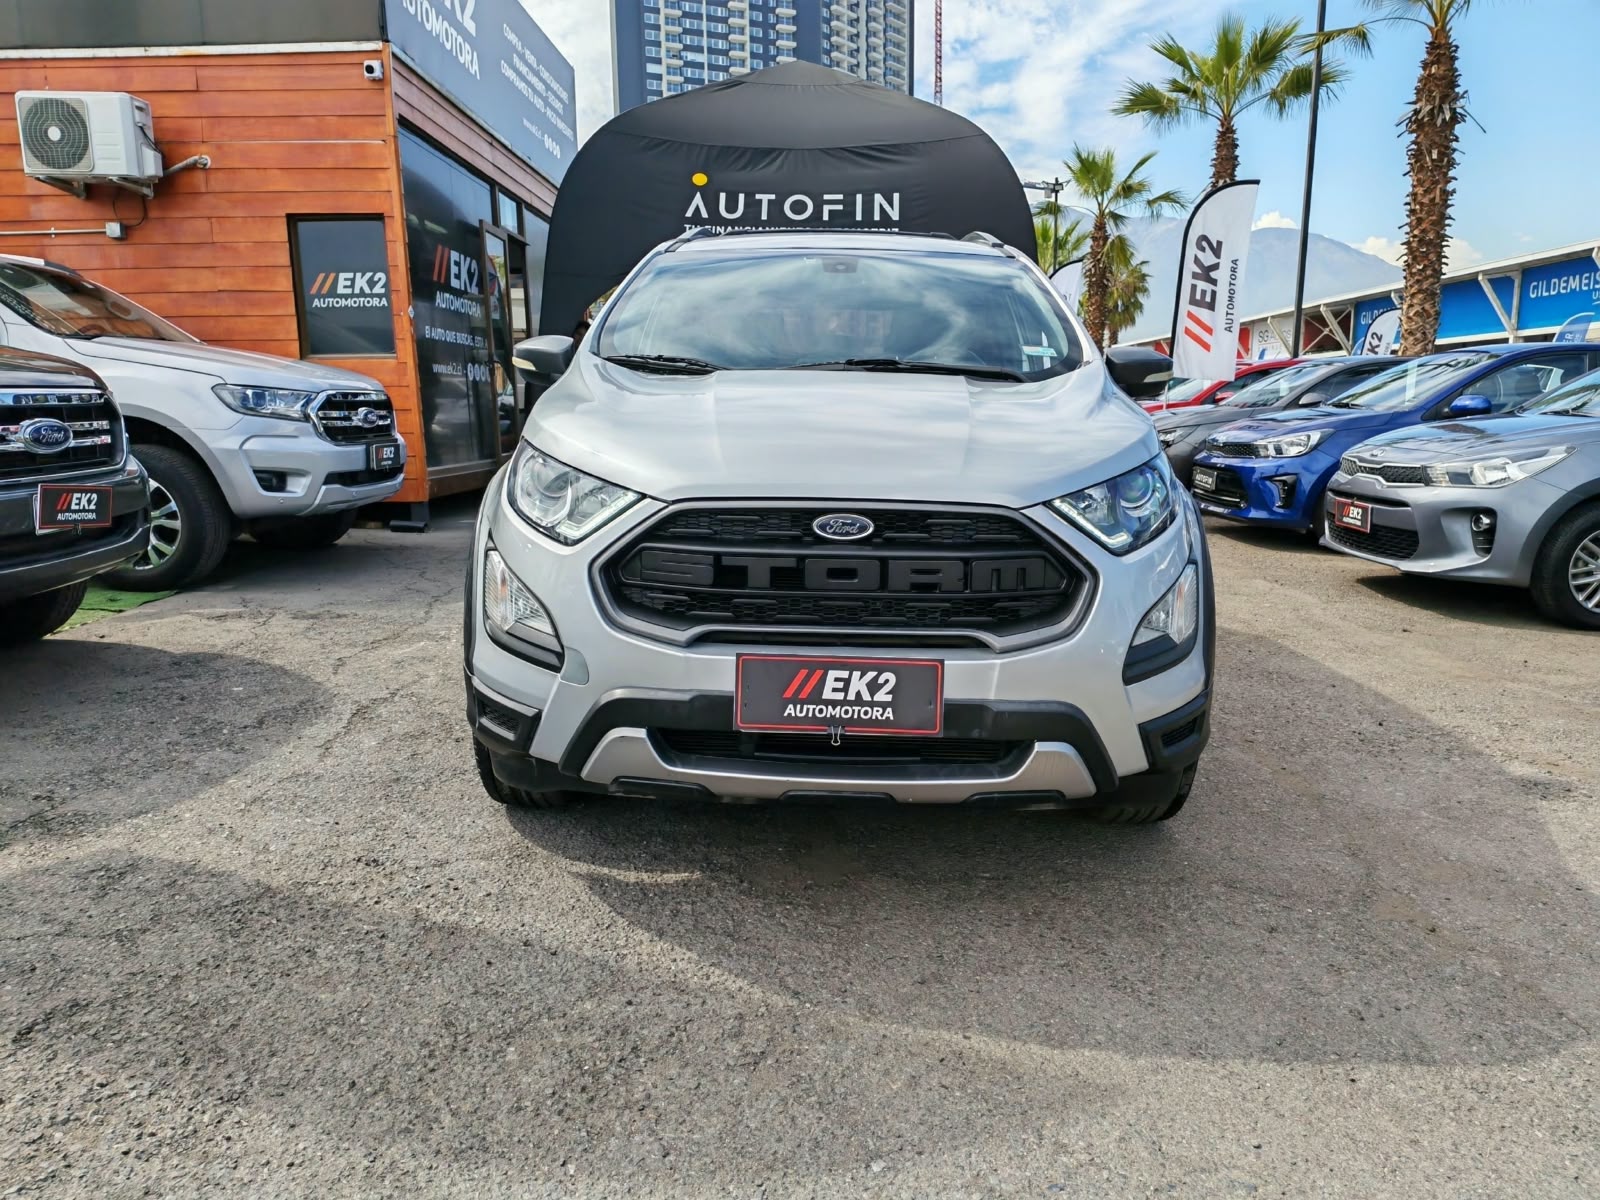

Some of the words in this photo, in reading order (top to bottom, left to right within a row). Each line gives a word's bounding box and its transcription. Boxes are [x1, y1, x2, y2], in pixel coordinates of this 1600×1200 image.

[402, 0, 480, 80] UTOMOTORA
[685, 192, 900, 221] AUTOFIN
[312, 298, 388, 307] AUTOMOTORA
[435, 290, 481, 318] AUTOMOTORA
[1224, 258, 1239, 333] AUTOMOTORA
[431, 327, 446, 341] AUTO
[445, 330, 457, 343] QUE
[1366, 331, 1383, 355] K2
[40, 426, 65, 443] Ford
[57, 512, 97, 521] AUTOMOTORA
[826, 518, 861, 536] Ford
[641, 551, 1046, 592] STORM
[783, 703, 895, 722] AUTOMOTORA
